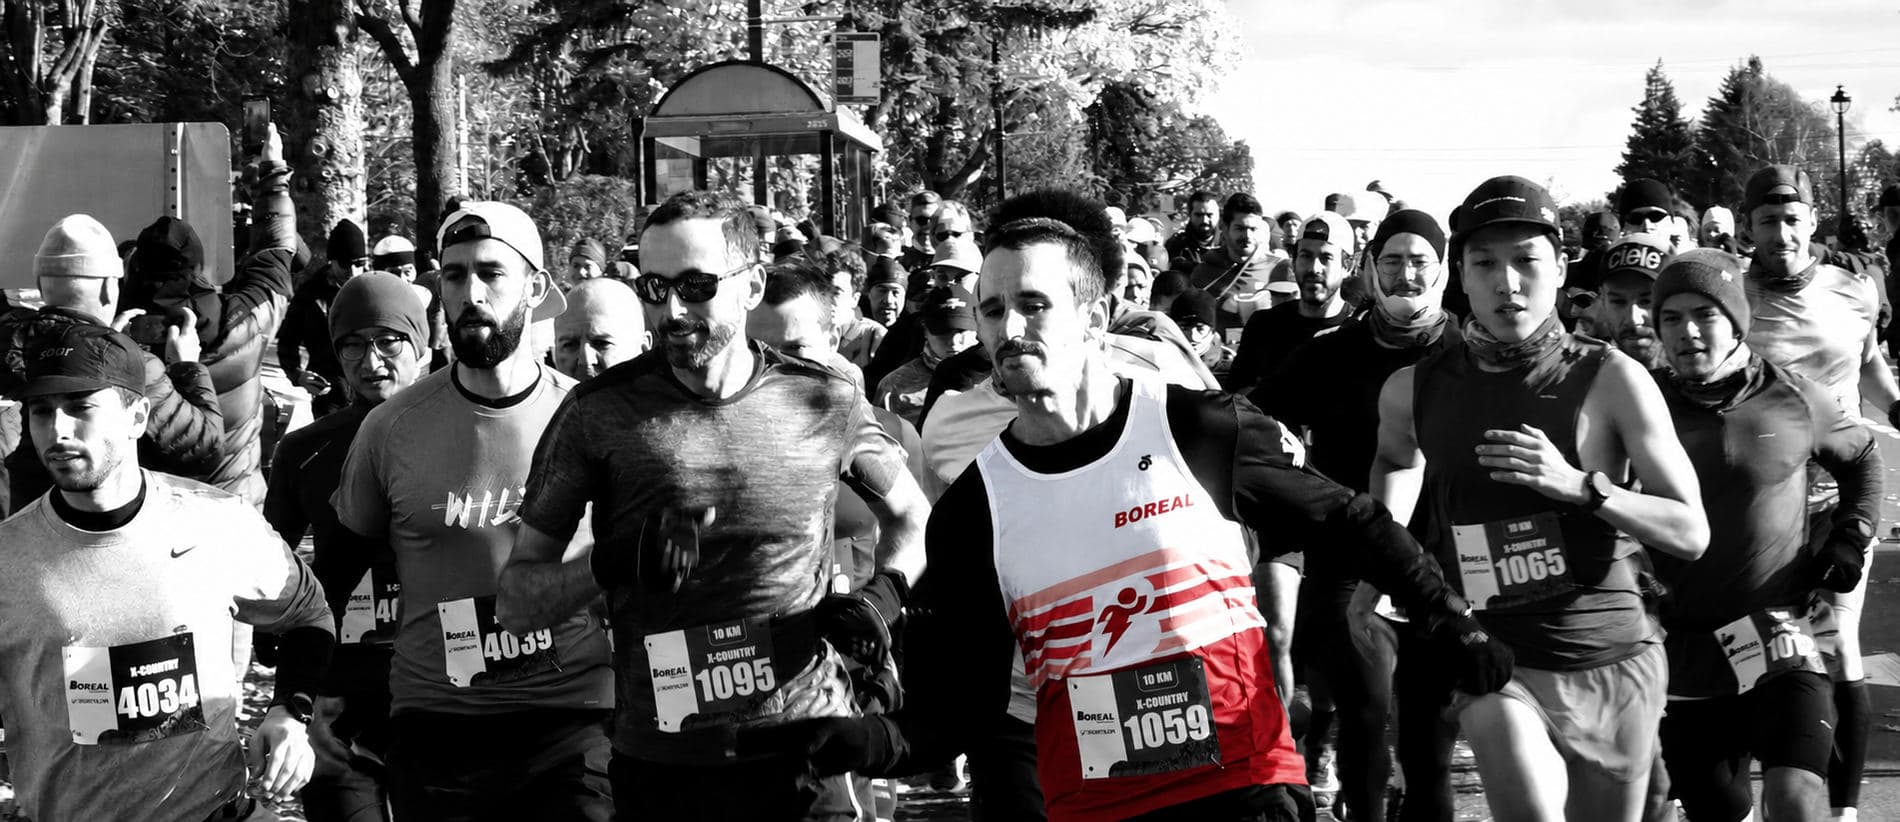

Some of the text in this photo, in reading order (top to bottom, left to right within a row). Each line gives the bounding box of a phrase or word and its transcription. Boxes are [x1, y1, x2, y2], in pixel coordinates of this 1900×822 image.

[1608, 245, 1661, 269] ciele
[40, 347, 74, 360] soar
[445, 488, 526, 529] WIL
[1114, 494, 1194, 529] BOREAL
[1495, 547, 1566, 586] 1065
[446, 630, 476, 640] BOREAL
[713, 625, 742, 640] 10 KM
[484, 628, 553, 661] 4039
[707, 645, 756, 664] X-COUNTRY
[129, 658, 180, 678] X-COUNTRY
[653, 666, 687, 678] BOREAL
[70, 680, 109, 691] BOREAL
[695, 656, 776, 702] 1095
[1143, 671, 1173, 686] 10 KM
[117, 673, 199, 719] 4034
[1136, 691, 1189, 710] X-COUNTRY
[1077, 711, 1114, 721] BOREAL
[1124, 704, 1210, 750] 1059
